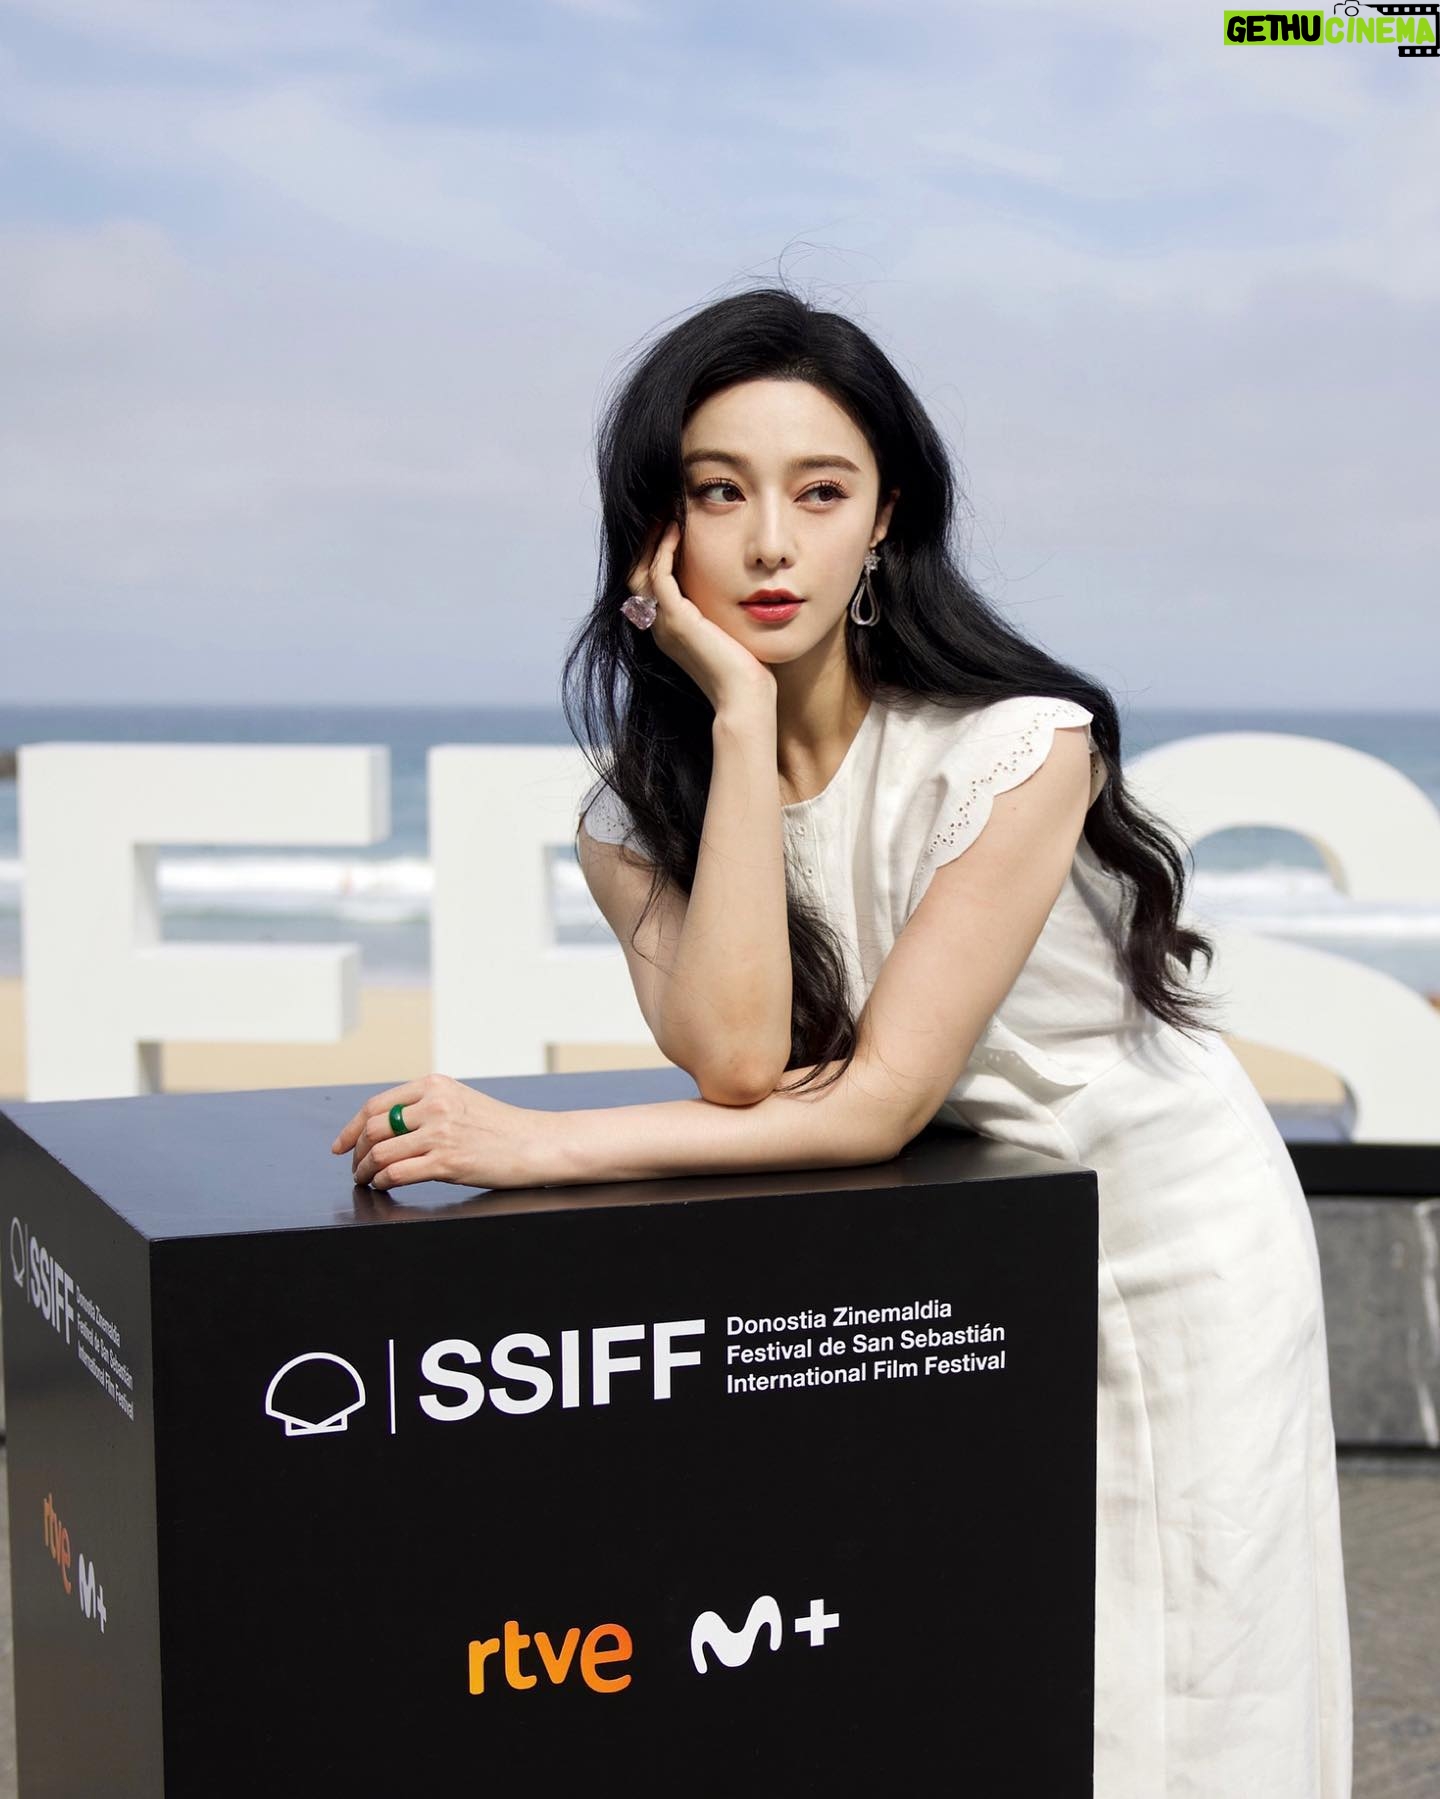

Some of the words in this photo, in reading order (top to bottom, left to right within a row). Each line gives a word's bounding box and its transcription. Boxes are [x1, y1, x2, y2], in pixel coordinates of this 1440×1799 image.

[29, 1236, 74, 1345] SSIFF
[726, 1310, 827, 1336] Donostia
[832, 1299, 952, 1327] Zinemaldia
[418, 1318, 706, 1422] SSIFF
[726, 1338, 812, 1365] Festival
[818, 1337, 846, 1357] de
[852, 1334, 894, 1354] San
[900, 1323, 1005, 1350] Sebastián
[726, 1362, 867, 1394] International
[873, 1359, 919, 1381] Film
[924, 1350, 1006, 1376] Festival
[43, 1492, 72, 1595] rtve
[468, 1620, 633, 1695] rtve
